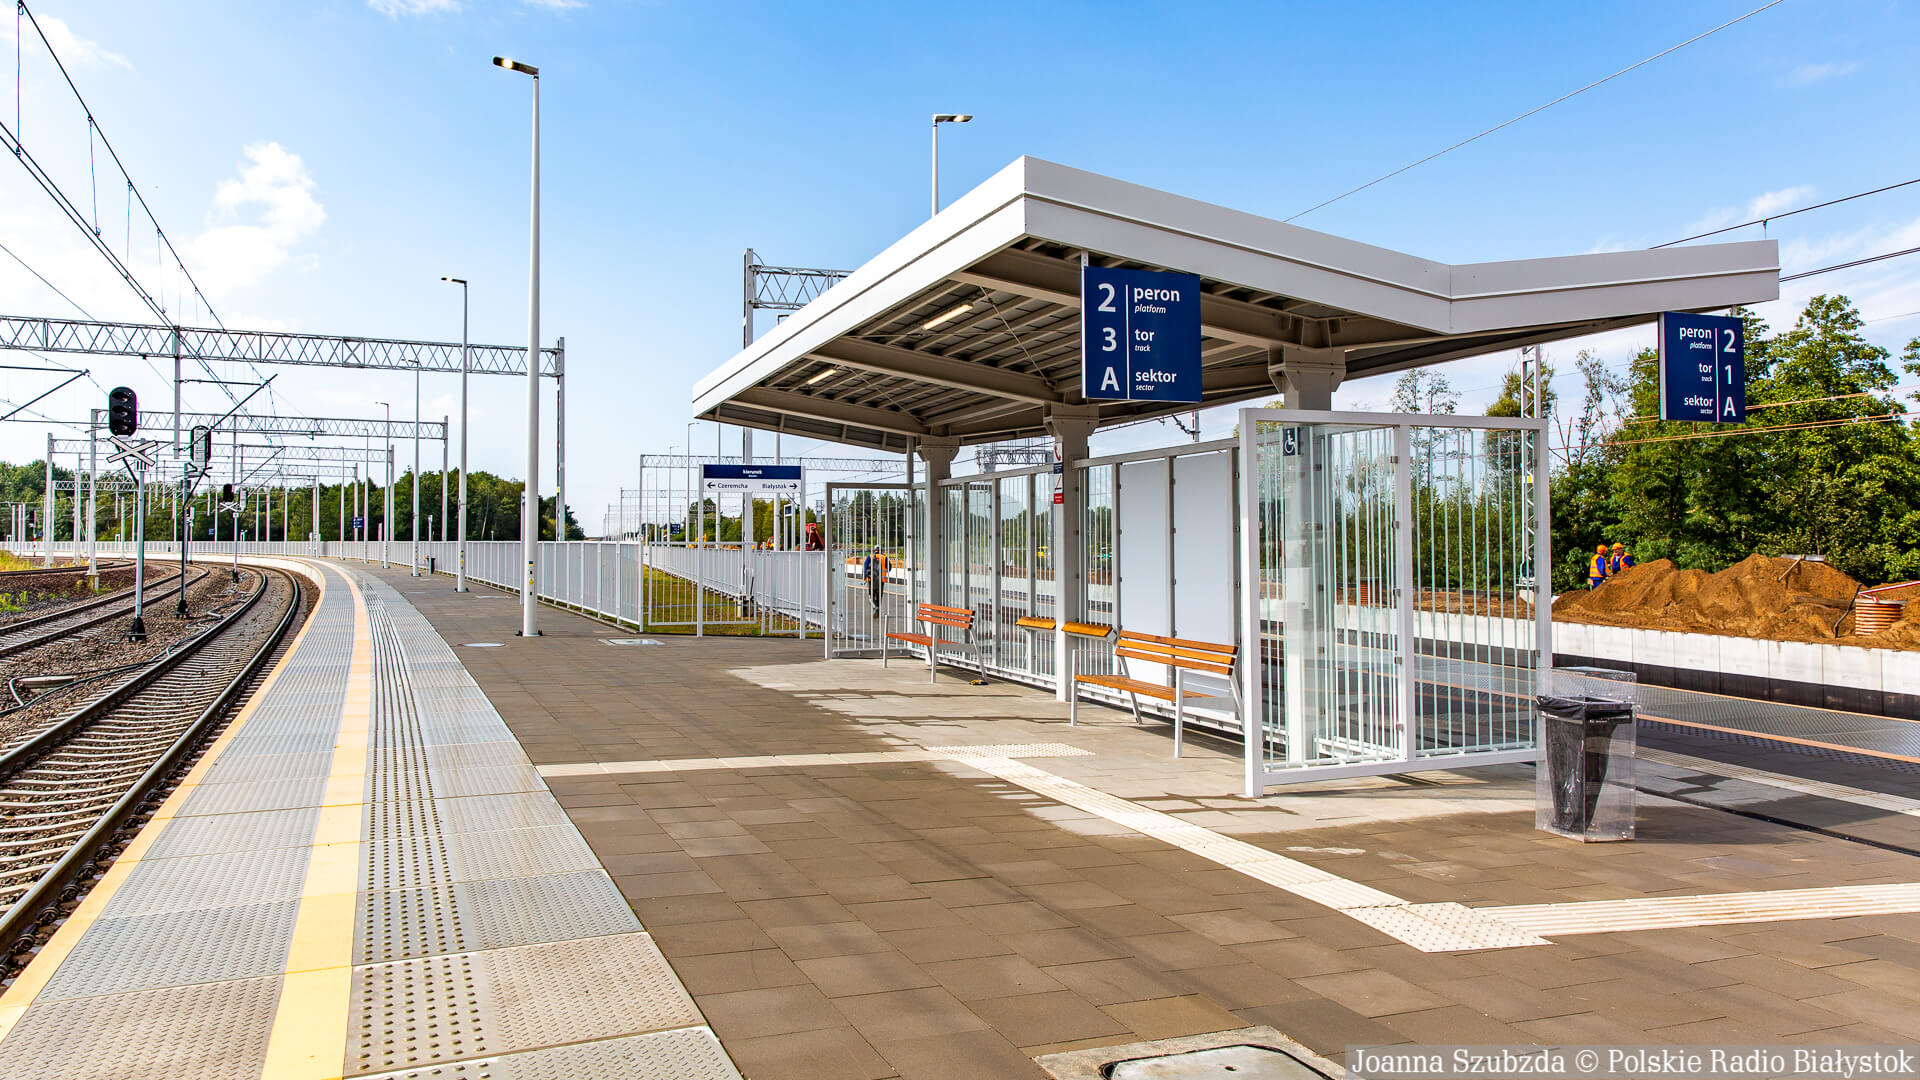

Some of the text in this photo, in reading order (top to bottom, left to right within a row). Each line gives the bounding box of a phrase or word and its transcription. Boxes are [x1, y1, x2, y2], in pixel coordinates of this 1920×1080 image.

[1098, 282, 1180, 313] 2 peron
[1134, 304, 1166, 314] platform
[1102, 327, 1155, 352] 3 tor
[1135, 344, 1151, 352] track
[1679, 327, 1736, 353] peron 2
[1689, 342, 1712, 350] platform
[1100, 366, 1177, 392] A sektor
[1698, 363, 1732, 385] tor 1
[1684, 395, 1737, 417] sektor A
